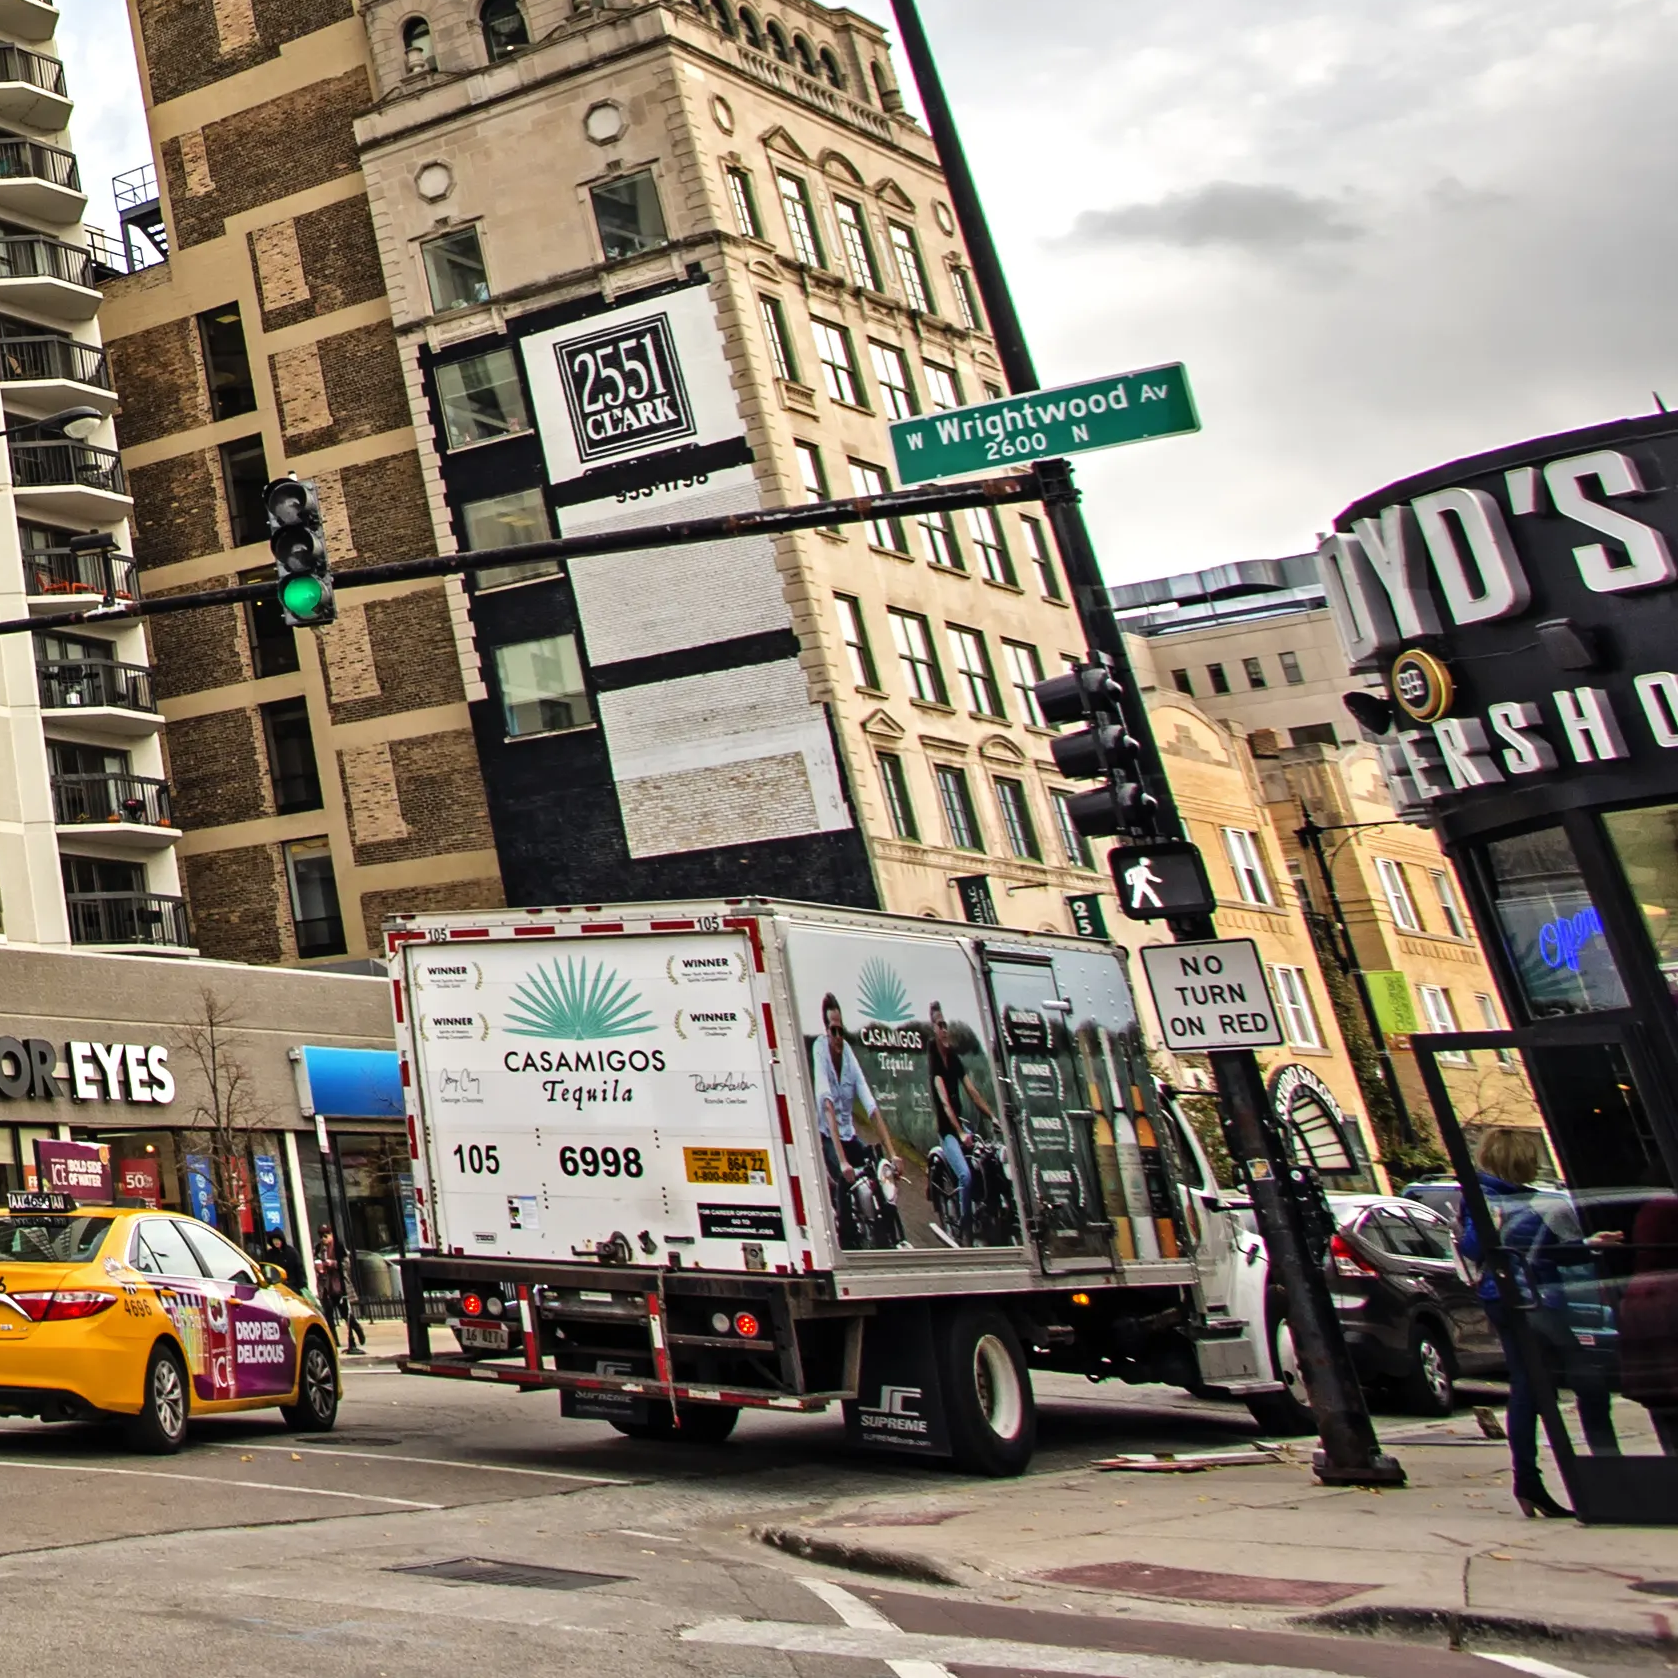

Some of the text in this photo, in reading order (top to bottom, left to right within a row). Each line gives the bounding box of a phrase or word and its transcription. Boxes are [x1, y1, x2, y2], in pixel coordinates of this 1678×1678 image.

[574, 332, 666, 414] 2551
[586, 395, 678, 440] CLARK
[906, 383, 1169, 451] W Wrightwood Av
[984, 423, 1090, 461] 2600 N
[428, 928, 447, 942] 105
[696, 916, 719, 931] 105
[427, 966, 468, 975] WINNER
[682, 958, 729, 968] WINNER
[1179, 955, 1223, 976] NO
[1174, 983, 1247, 1006] TURN
[433, 1017, 473, 1026] WINNER
[690, 1012, 737, 1022] WINNER
[1170, 1013, 1268, 1036] ON RED
[860, 1027, 923, 1049] CASAMIGOS
[504, 1049, 666, 1072] CASAMIGOS
[877, 1052, 914, 1077] Tequila
[65, 1041, 176, 1104] EYES
[543, 1079, 633, 1111] Tequila
[453, 1144, 500, 1174] 105
[559, 1145, 644, 1178] 6998
[51, 1163, 68, 1186] ICE
[7, 1193, 25, 1209] TAXI
[49, 1194, 64, 1209] TAXI
[123, 1297, 152, 1318] 4696
[235, 1321, 281, 1341] DROP RED
[236, 1344, 285, 1364] DELICIOUS
[212, 1354, 236, 1389] ICE
[860, 1414, 928, 1433] SUPREME
